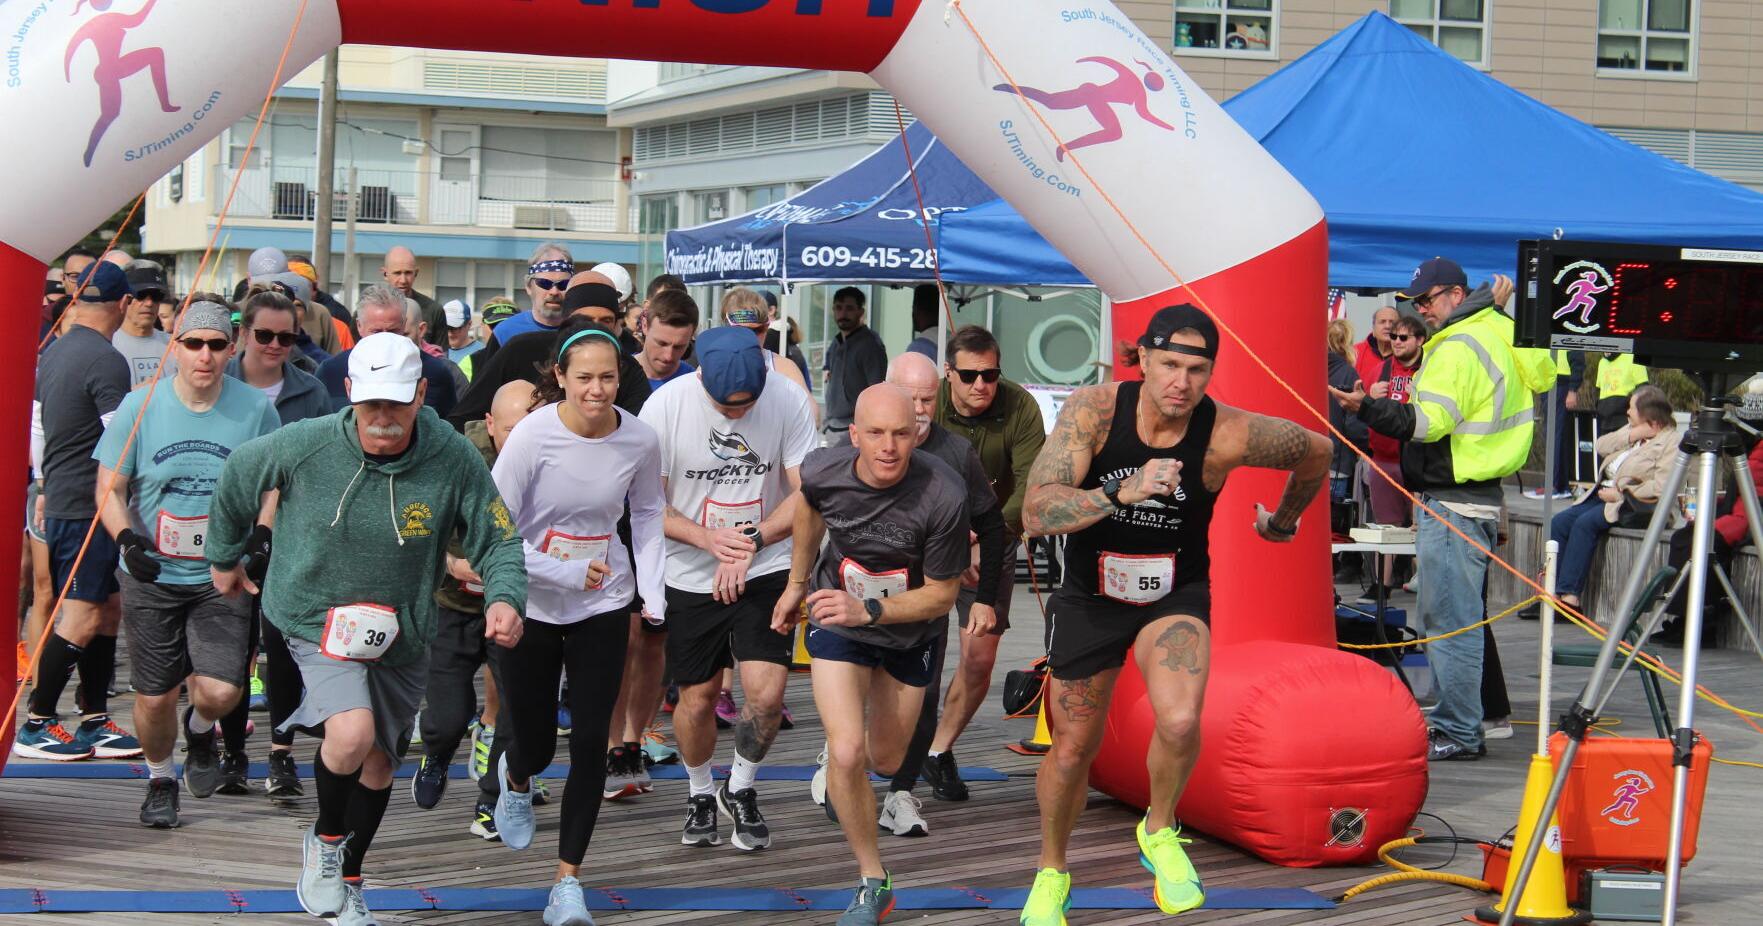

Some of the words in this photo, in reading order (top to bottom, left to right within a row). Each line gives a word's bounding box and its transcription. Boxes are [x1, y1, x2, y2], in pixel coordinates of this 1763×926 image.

[12, 2, 47, 42] Jersey
[7, 45, 21, 88] South
[1061, 8, 1098, 22] South
[1099, 11, 1134, 39] Jersey
[1165, 67, 1190, 110] Timing
[1184, 111, 1197, 140] LLC
[124, 89, 222, 162] SJTiming.Com
[999, 119, 1081, 197] SJTiming.Com
[711, 242, 744, 278] Physical
[743, 242, 779, 277] Therapy
[173, 442, 188, 450] THE
[189, 442, 221, 451] BOARDS
[1132, 510, 1167, 523] FLAT
[1138, 576, 1161, 591] 55
[364, 629, 387, 647] 39
